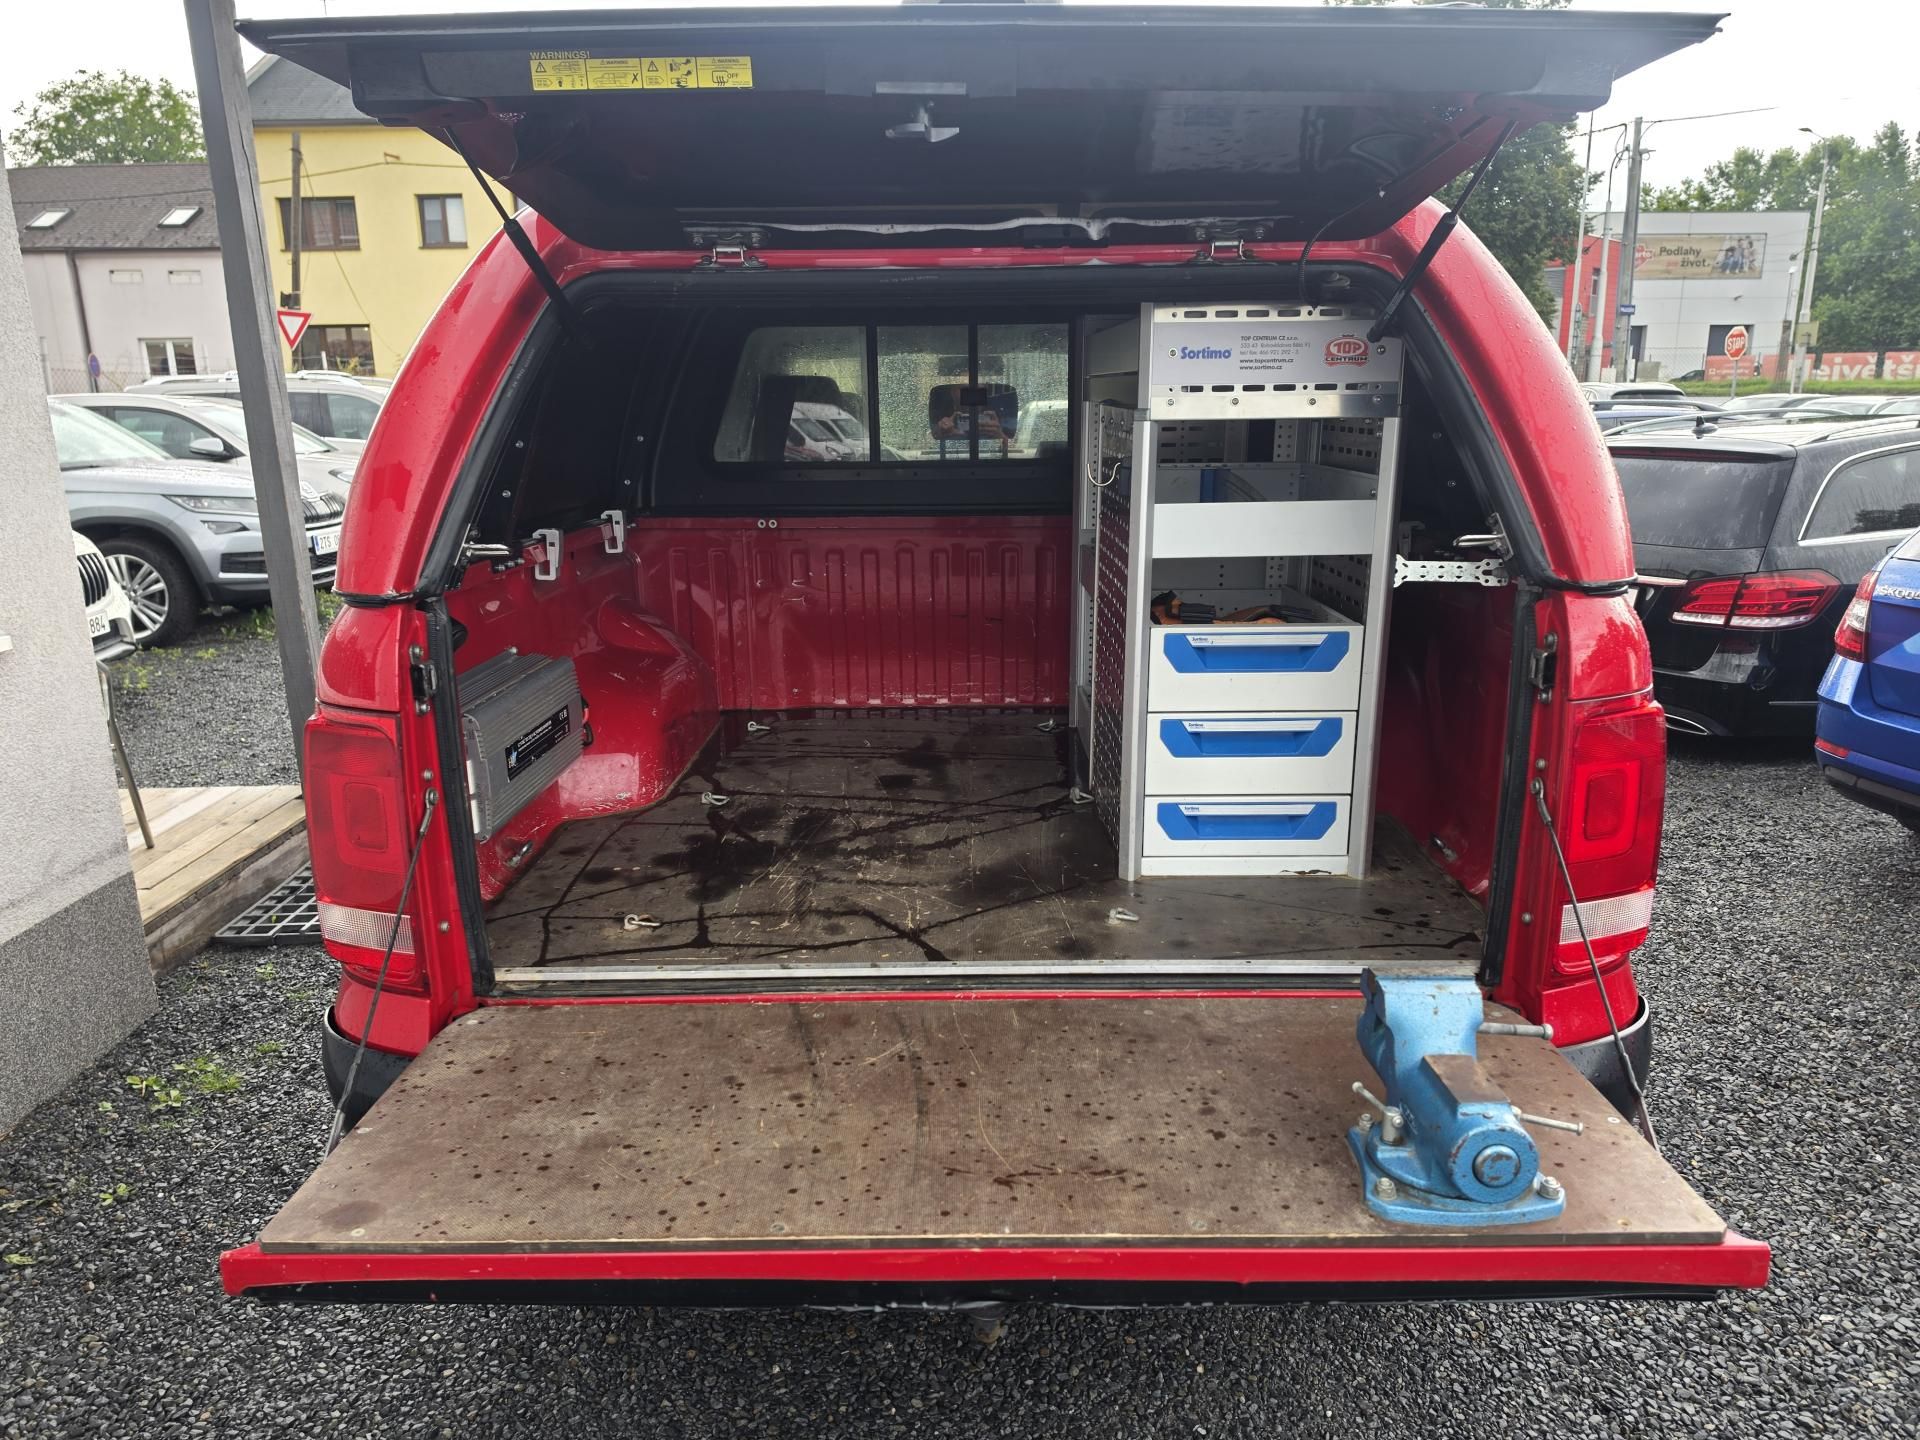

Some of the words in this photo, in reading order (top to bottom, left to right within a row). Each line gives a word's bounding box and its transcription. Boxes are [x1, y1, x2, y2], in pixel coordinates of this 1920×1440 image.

[530, 51, 590, 59] WARNINGS!
[1659, 246, 1701, 257] Podlahy
[1334, 341, 1362, 353] TOP
[1727, 336, 1745, 351] STOP
[1180, 347, 1231, 359] Sortimo
[89, 615, 106, 633] 884
